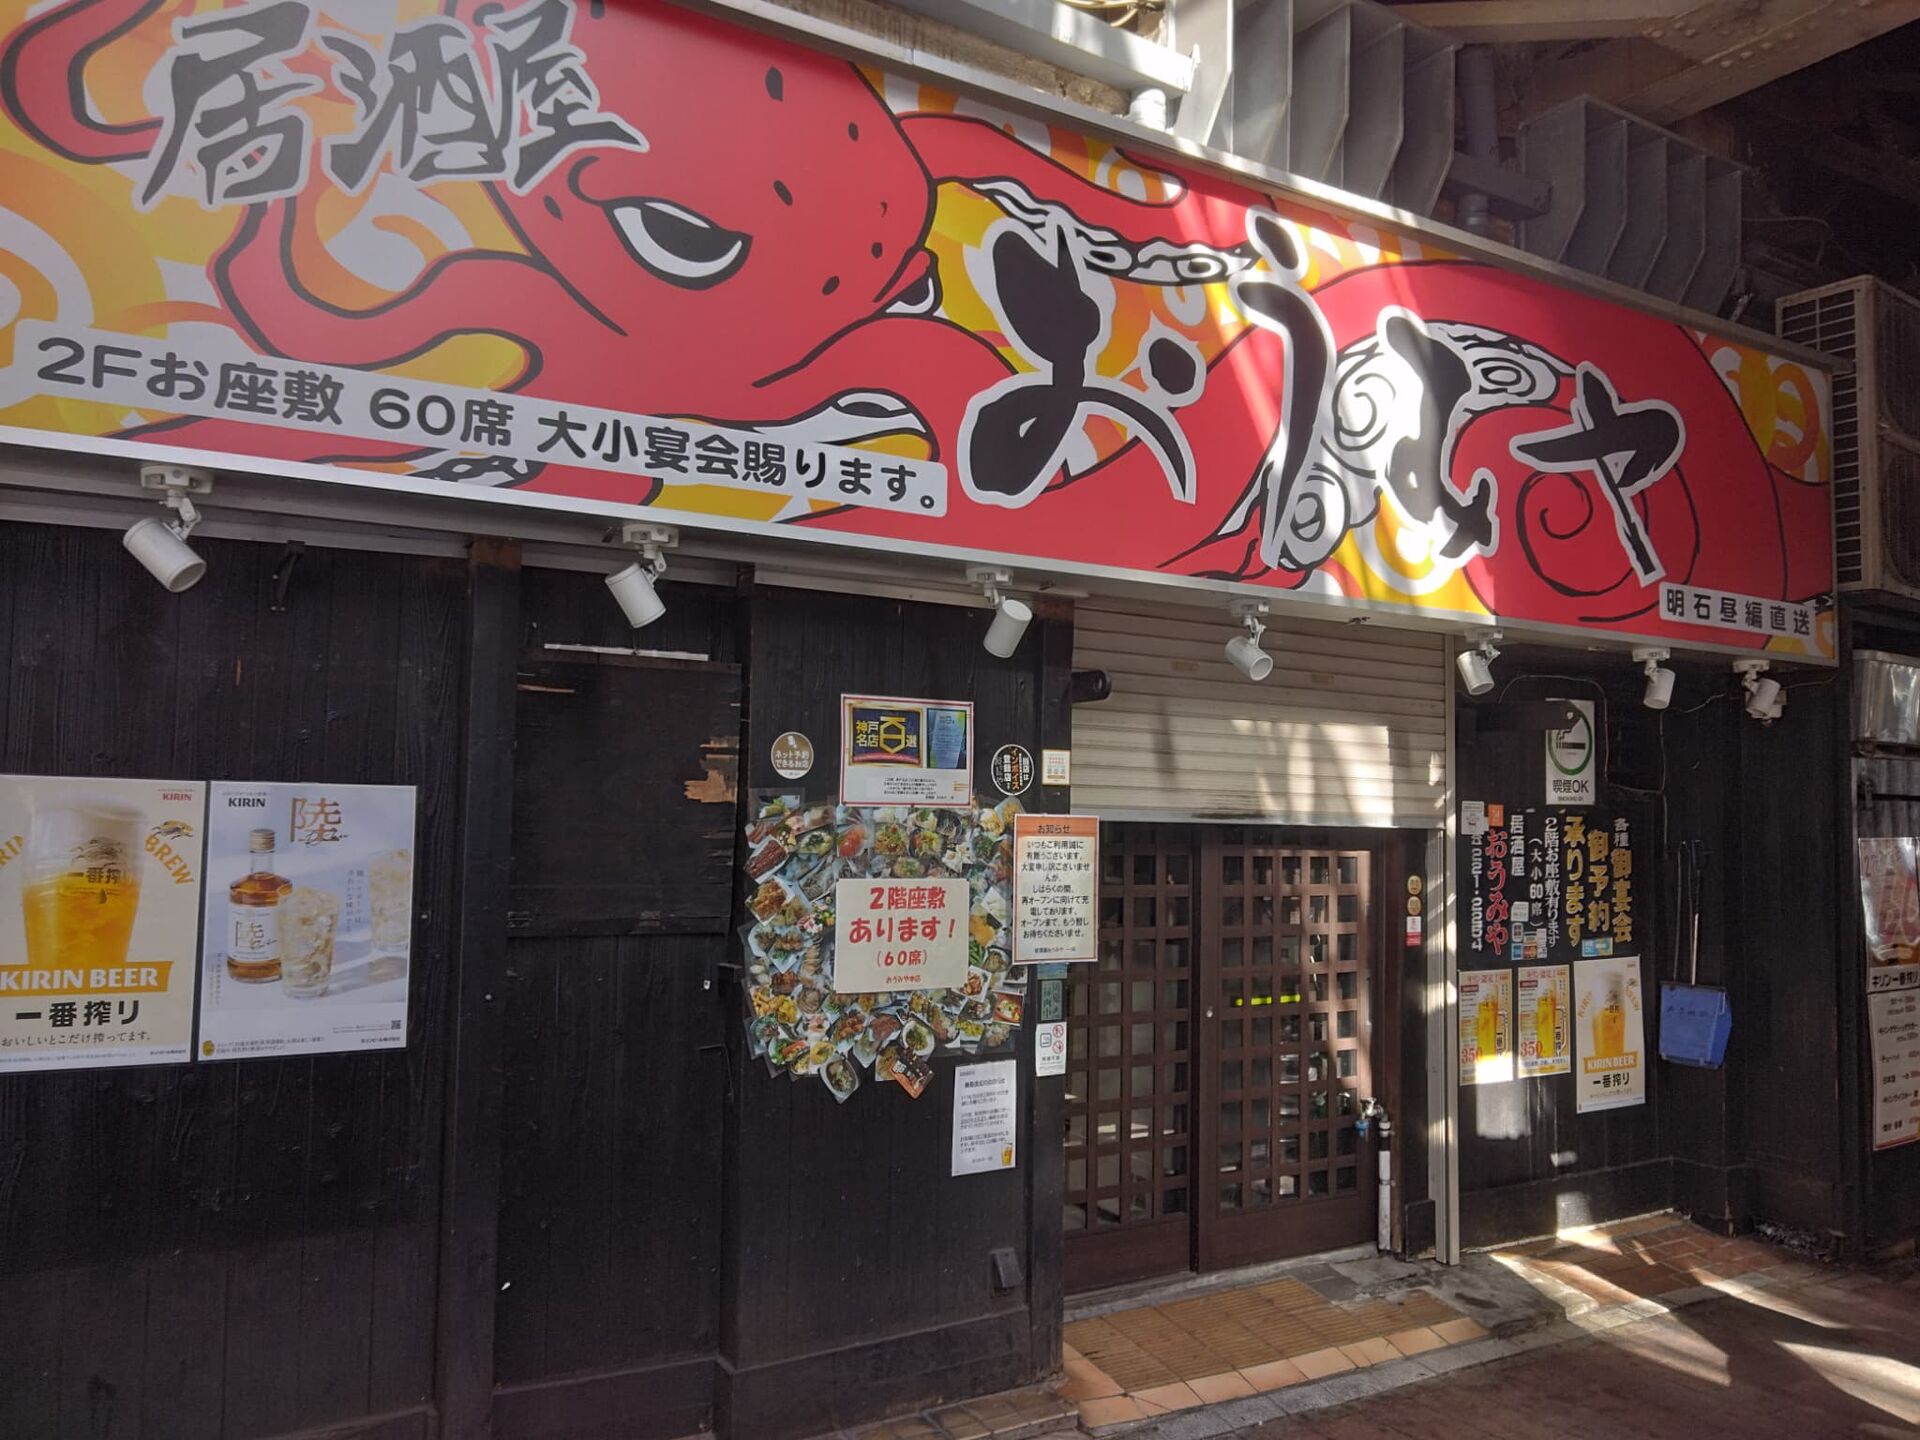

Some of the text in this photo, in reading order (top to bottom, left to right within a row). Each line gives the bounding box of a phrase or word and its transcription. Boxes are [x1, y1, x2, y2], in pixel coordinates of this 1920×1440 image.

[138, 0, 646, 206] 居酒屋
[37, 336, 936, 511] 2Fお座敷 60席 大小宴会賜ります。
[163, 792, 193, 801] KIRIN
[1553, 779, 1589, 793] 喫煙OK
[228, 797, 266, 808] KIRIN
[289, 797, 342, 843] 陸
[1038, 824, 1071, 834] お知らせ
[144, 834, 194, 885] BREW
[1510, 815, 1525, 877] 居酒屋
[1485, 828, 1509, 956] おうみや
[1563, 816, 1586, 948] 承ります
[1587, 828, 1610, 933] 御予約
[869, 886, 946, 910] 2階座敷
[1, 967, 158, 991] KIRIN BEER
[16, 1000, 139, 1028] 一番搾り
[1520, 1040, 1543, 1059] 350
[1592, 1072, 1630, 1088] 一番搾り
